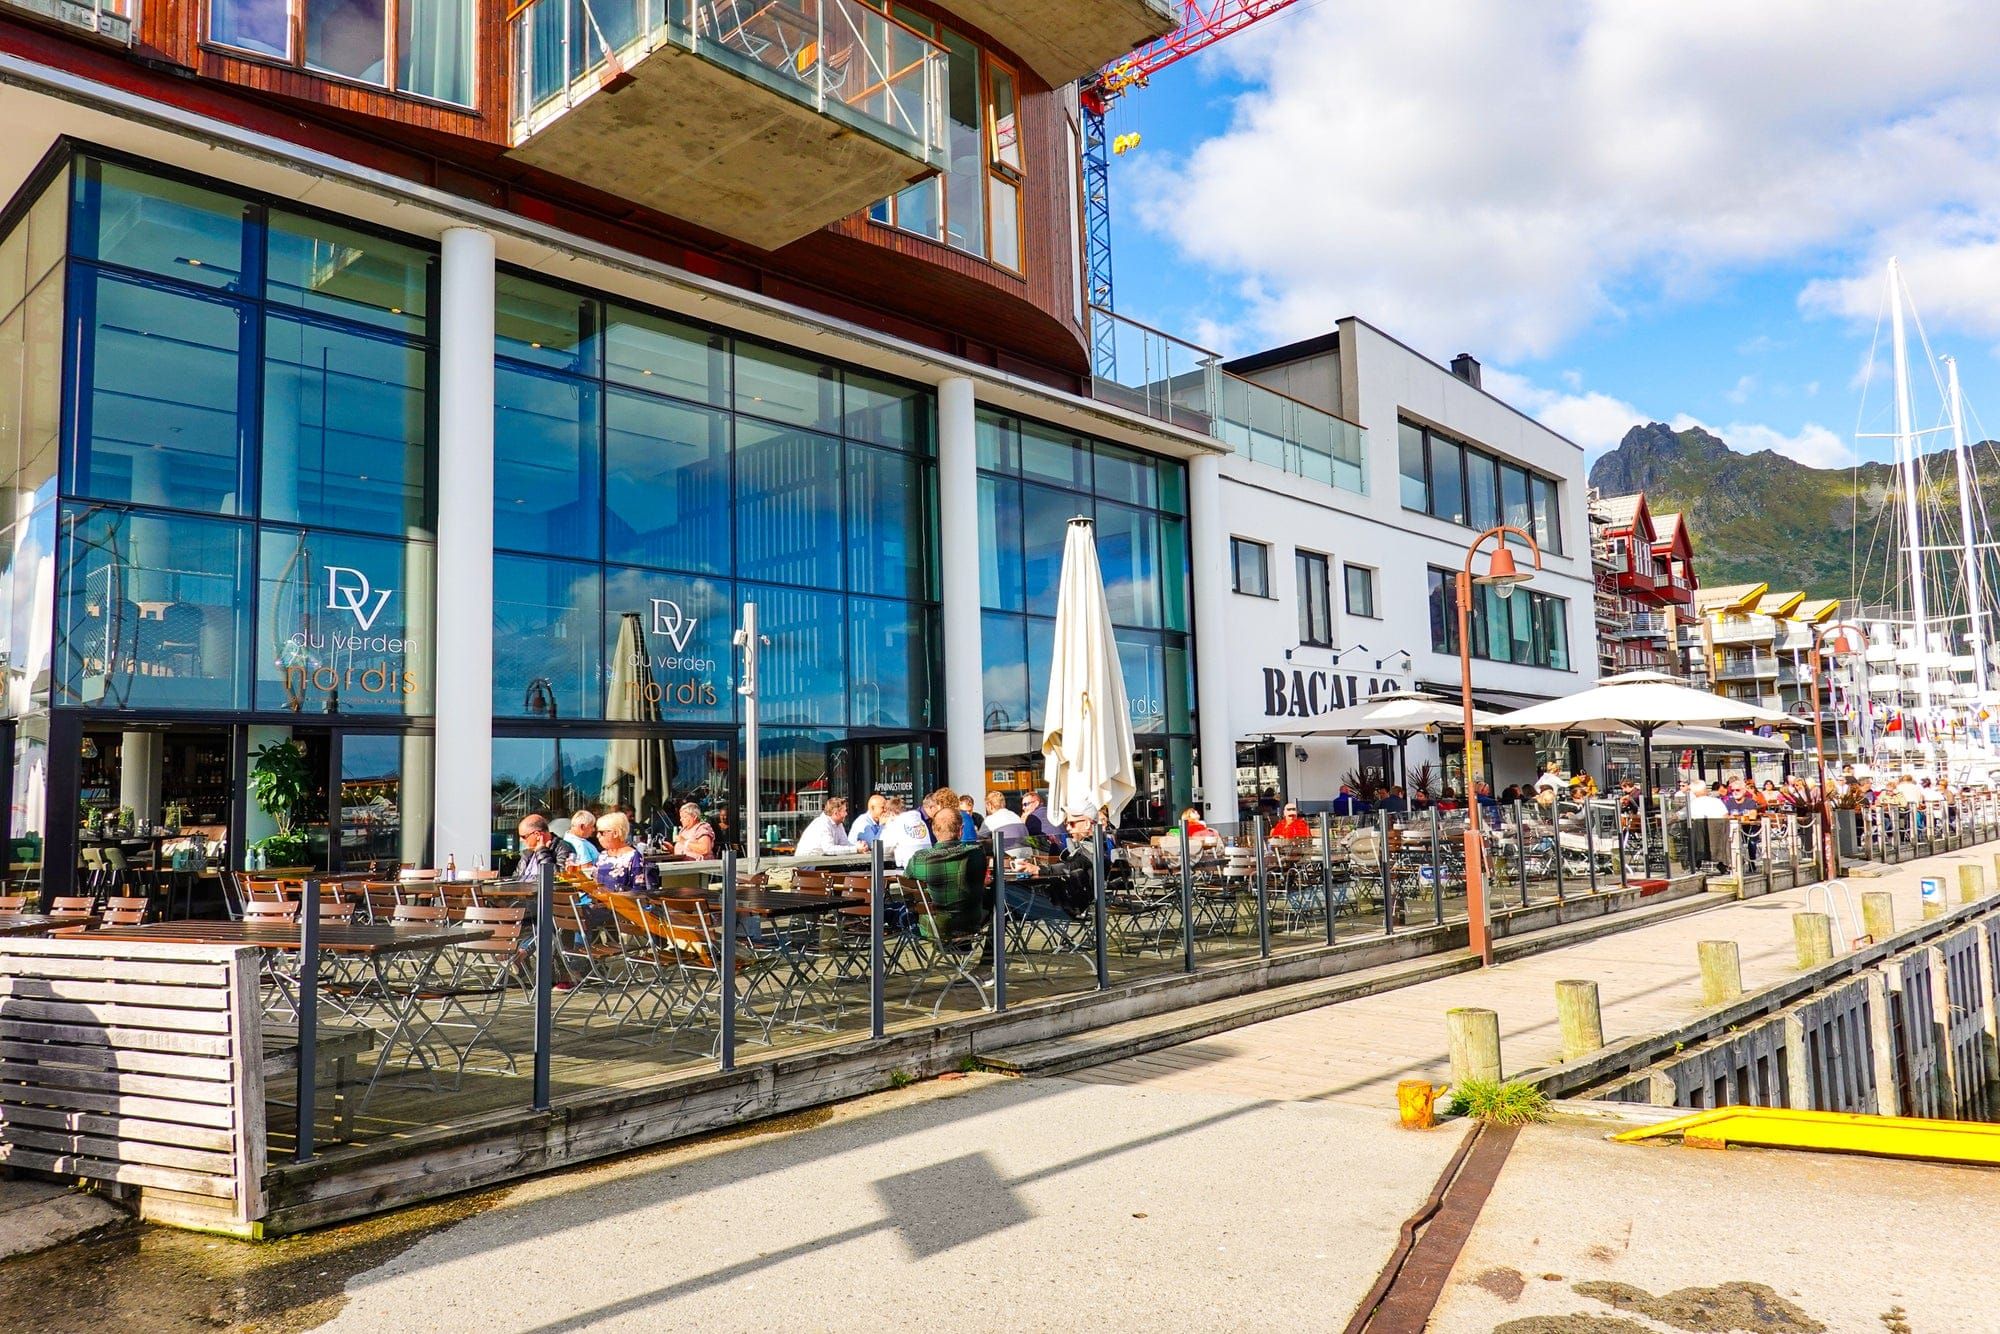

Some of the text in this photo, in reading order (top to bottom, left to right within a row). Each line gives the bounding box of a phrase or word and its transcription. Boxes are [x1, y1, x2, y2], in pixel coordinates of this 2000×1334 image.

[323, 565, 393, 631] DV
[291, 628, 417, 654] du verden
[650, 598, 698, 653] DV
[628, 651, 716, 672] du verden
[287, 661, 417, 695] nordis
[624, 677, 717, 705] nordis
